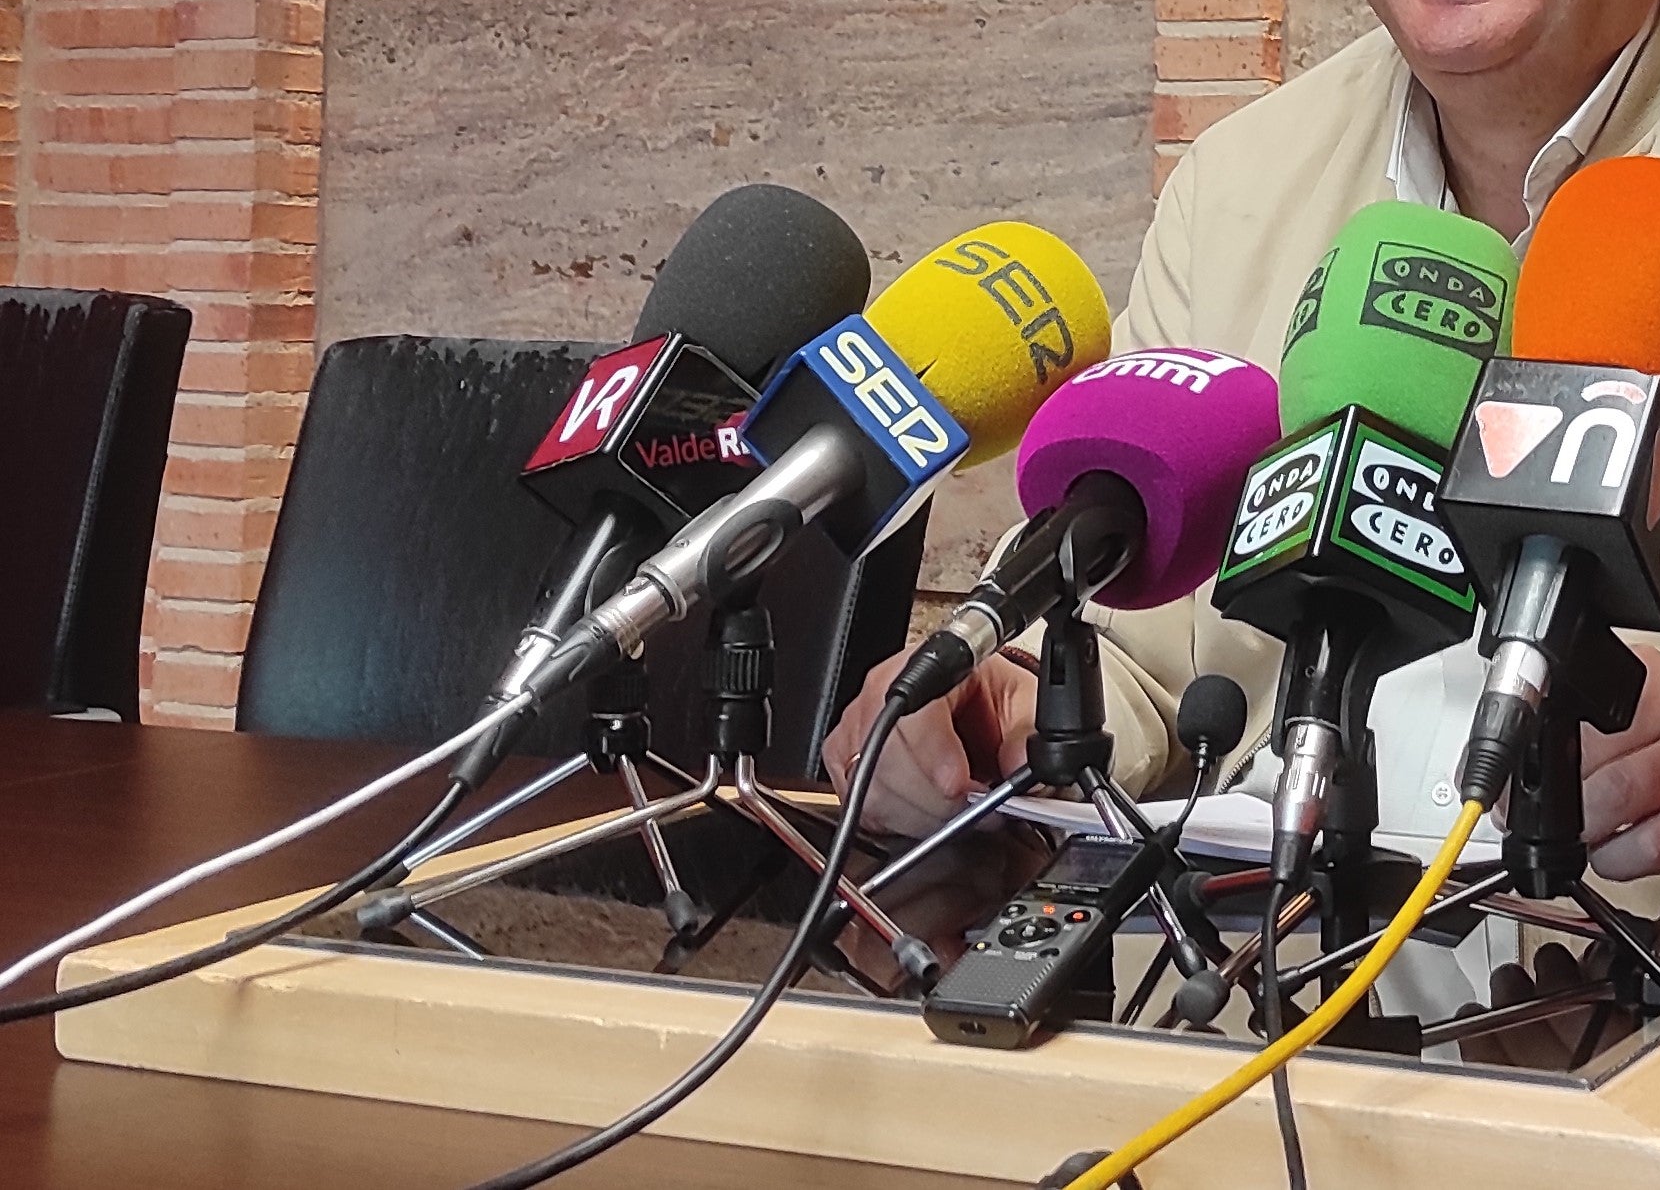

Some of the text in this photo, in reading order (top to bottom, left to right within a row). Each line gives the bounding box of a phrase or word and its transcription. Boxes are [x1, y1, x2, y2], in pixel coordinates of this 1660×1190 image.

[1394, 260, 1486, 303] ONDA
[935, 240, 1075, 385] SER
[1391, 292, 1481, 338] CERO
[559, 364, 640, 443] VR
[819, 331, 950, 469] SER
[635, 425, 752, 469] ValdeR
[1253, 459, 1314, 508] ONDA
[1246, 499, 1305, 545] CERO
[1369, 511, 1455, 565] CERO
